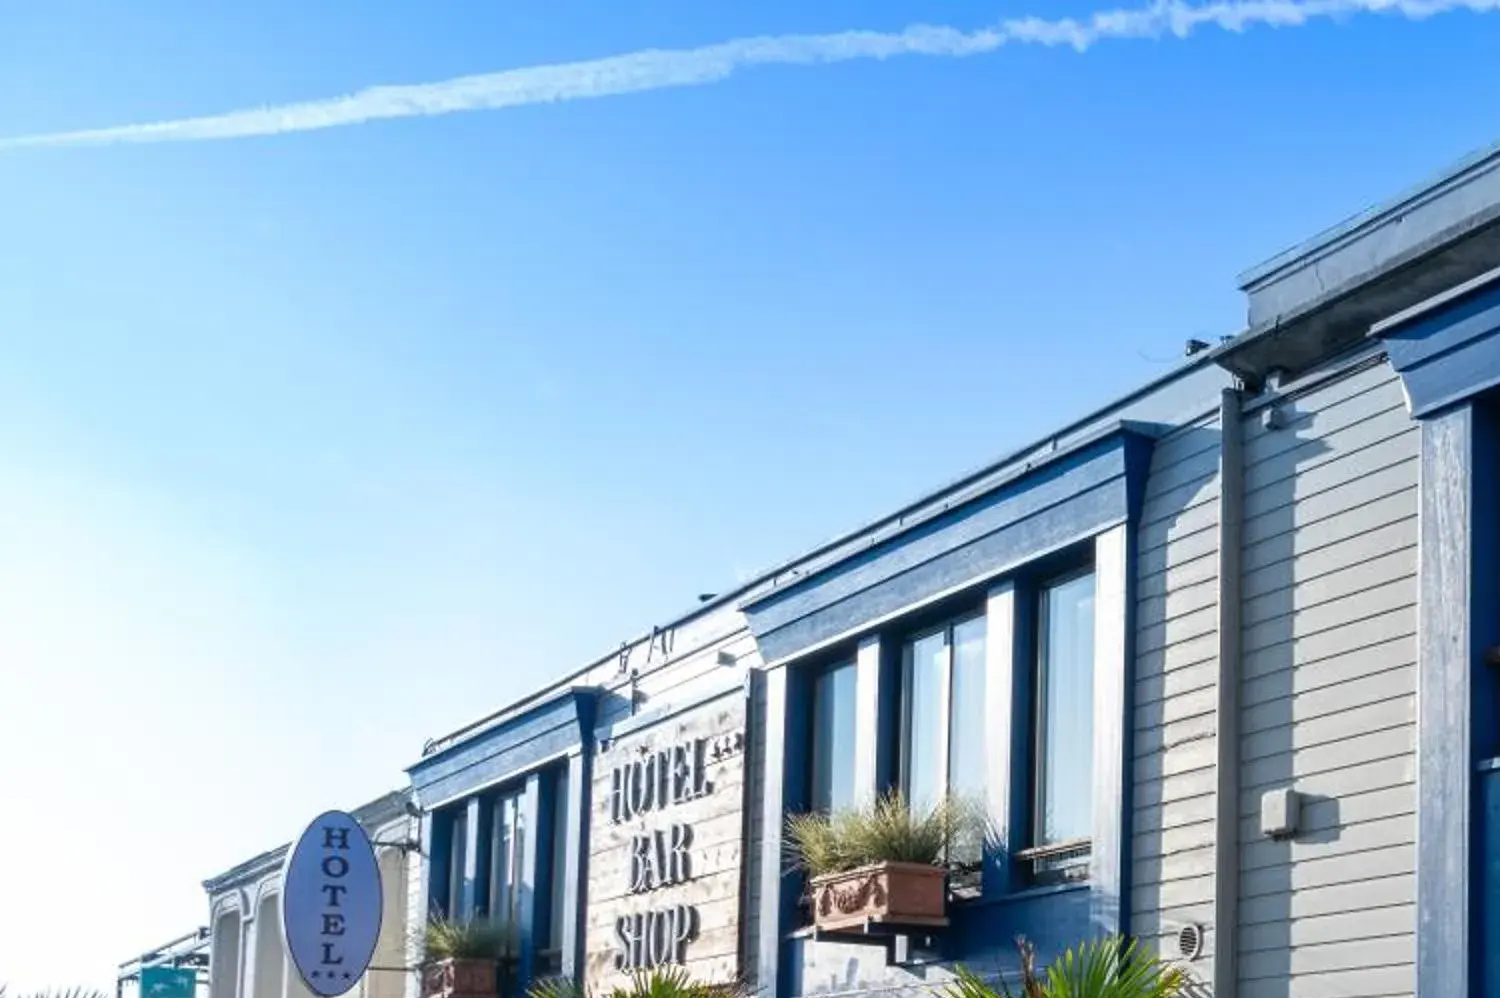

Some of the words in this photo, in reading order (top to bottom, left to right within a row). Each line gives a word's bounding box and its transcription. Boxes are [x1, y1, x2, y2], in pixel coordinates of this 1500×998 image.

[609, 738, 714, 825] HOTEL
[320, 826, 351, 965] HOTEL
[629, 825, 695, 894] BAR
[614, 903, 701, 975] SHOP
